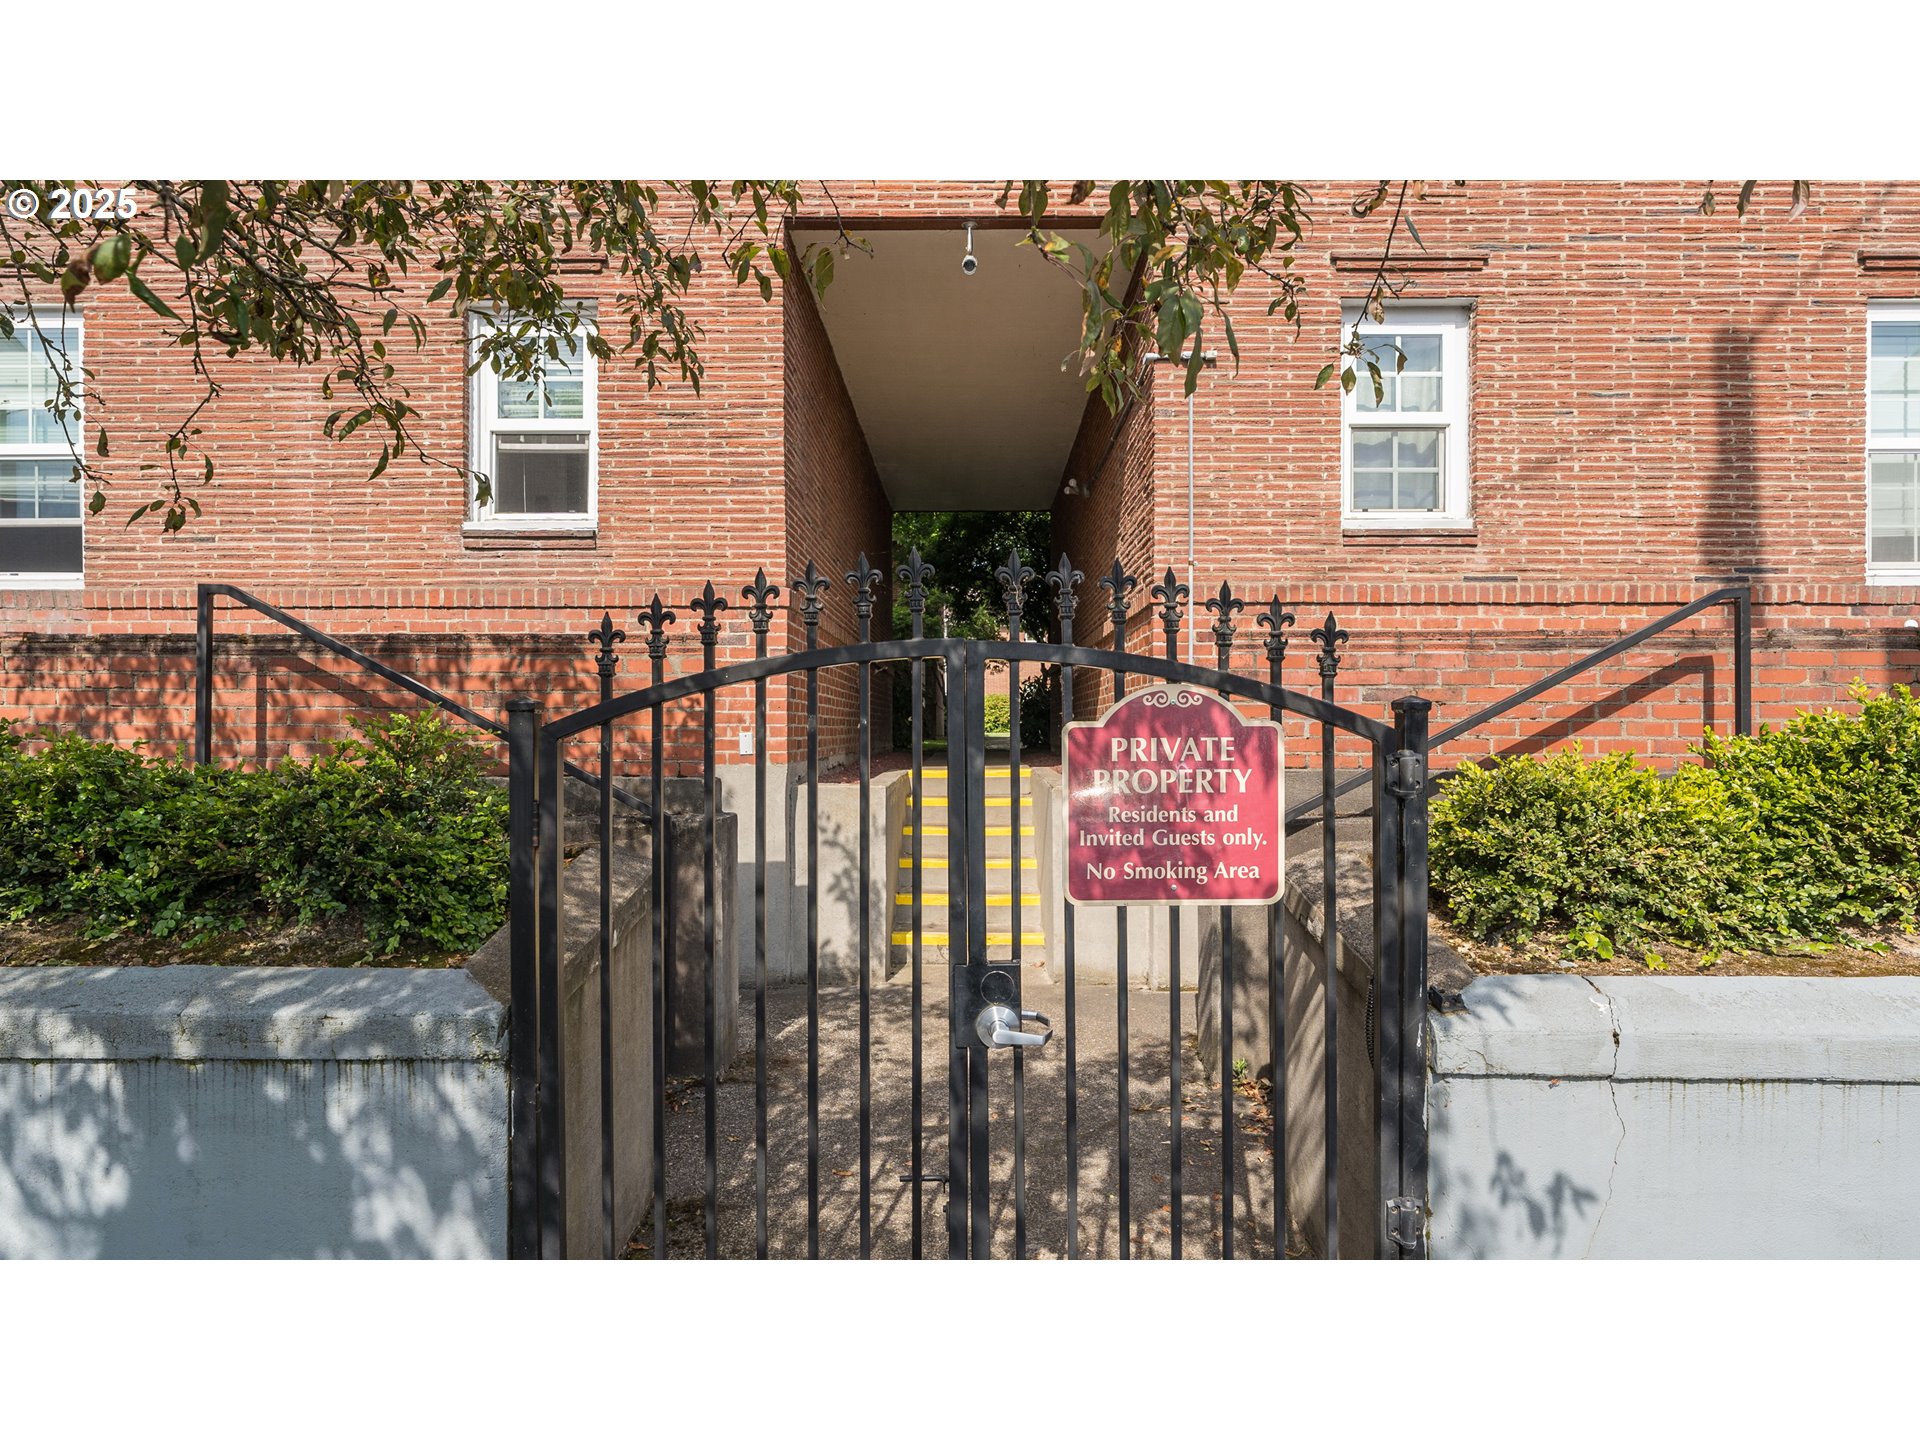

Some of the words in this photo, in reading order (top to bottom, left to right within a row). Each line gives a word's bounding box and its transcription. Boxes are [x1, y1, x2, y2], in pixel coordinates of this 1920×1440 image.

[1111, 737, 1235, 762] PRIVATE
[1093, 768, 1252, 794] PROPERTY
[1108, 805, 1197, 823] Residents
[1204, 804, 1238, 823] and
[1079, 828, 1144, 846] Invited
[1152, 829, 1215, 846] Guests
[1222, 827, 1267, 850] only.
[1086, 862, 1116, 880] No
[1123, 860, 1208, 884] Smoking
[1214, 861, 1260, 879] Area
